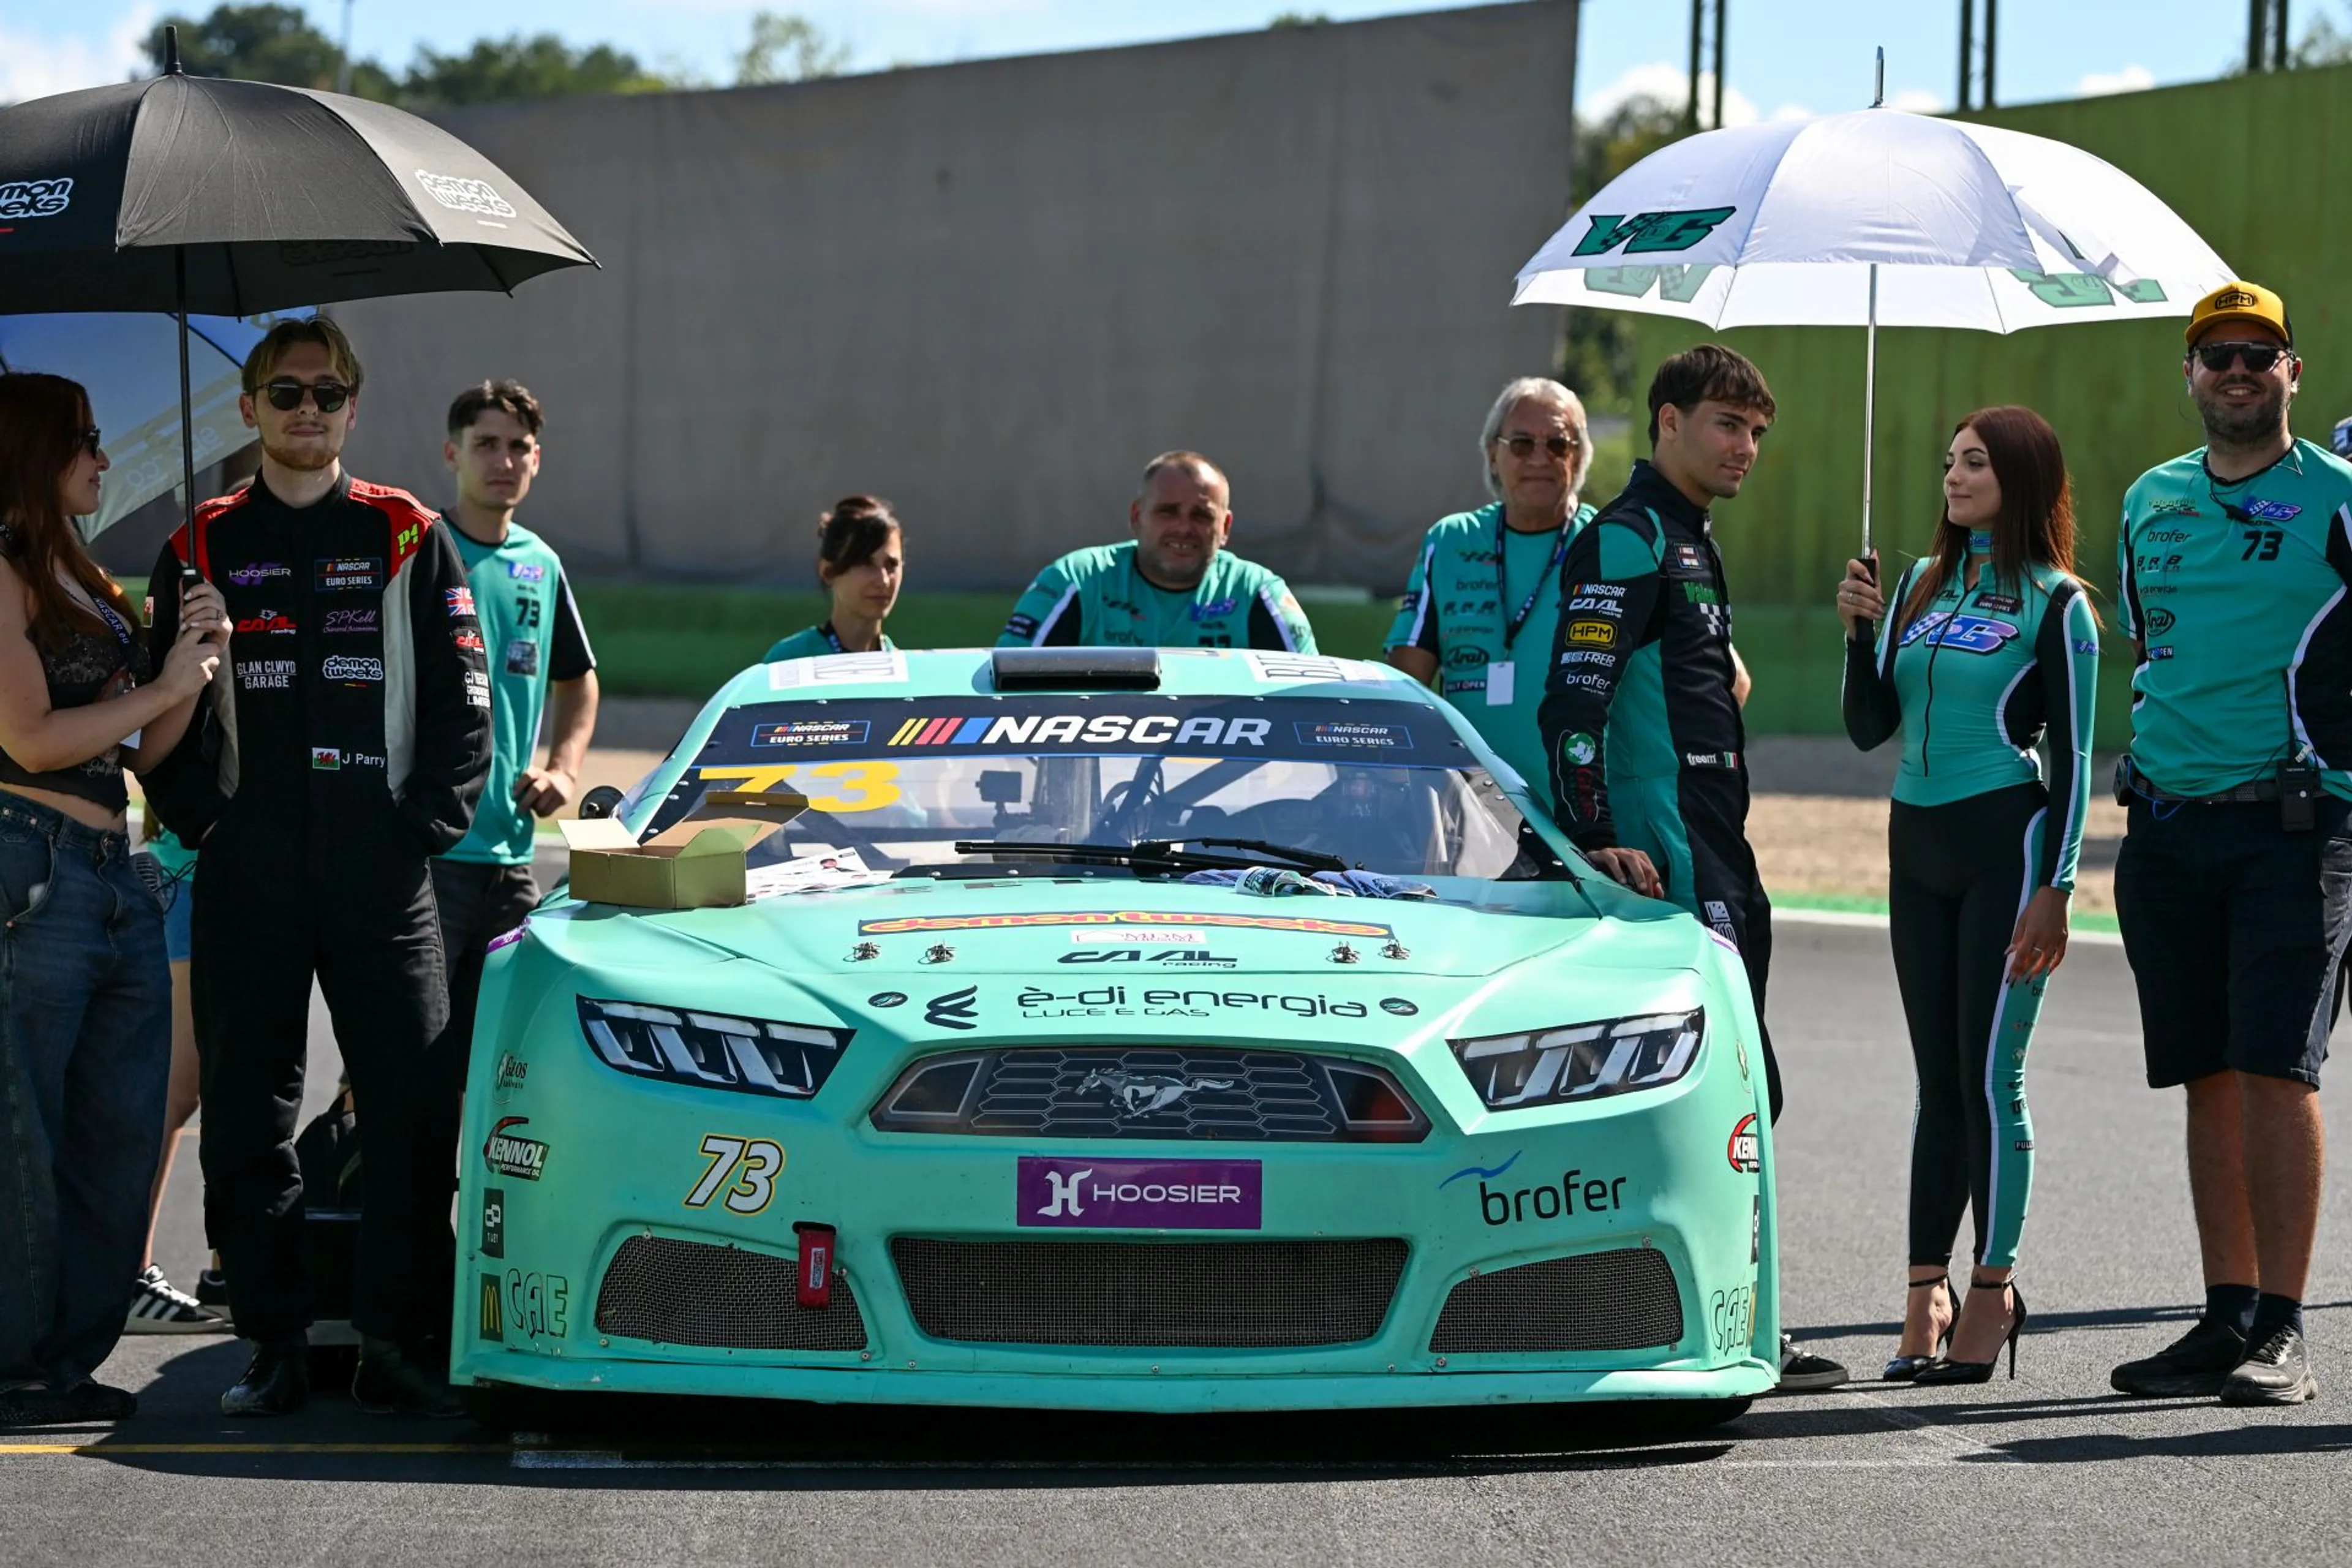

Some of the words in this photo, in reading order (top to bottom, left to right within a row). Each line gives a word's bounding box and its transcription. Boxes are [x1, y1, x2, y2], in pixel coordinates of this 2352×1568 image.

[0, 178, 74, 199] mon
[2217, 293, 2252, 305] HPM
[2147, 529, 2192, 543] brofer
[2241, 530, 2284, 561] 73
[228, 568, 292, 578] HOOSIER
[336, 562, 371, 571] NASCAR
[325, 576, 347, 586] EURO
[347, 576, 372, 585] SERIES
[1584, 583, 1627, 598] NASCAR
[515, 597, 542, 628] 73
[1572, 625, 1611, 641] HPM
[236, 662, 262, 675] GLAN
[264, 660, 296, 674] CLWYD
[323, 655, 381, 669] demon
[322, 666, 383, 680] tweeks
[244, 674, 290, 690] GARAGE
[1566, 673, 1611, 691] brofer
[792, 723, 851, 733] NASCAR
[981, 716, 1272, 746] NASCAR
[1332, 725, 1389, 735] NASCAR
[769, 735, 804, 744] EURO
[805, 734, 849, 742] SERIES
[1316, 736, 1349, 744] EURO
[1352, 736, 1395, 746] SERIES
[342, 753, 351, 764] J
[355, 753, 386, 768] Parry
[1057, 949, 1238, 963] CAAL
[1017, 986, 1126, 1008] è-di
[1144, 989, 1368, 1018] energia
[1022, 1008, 1106, 1019] LUCE
[1115, 1008, 1135, 1016] E
[1144, 1008, 1210, 1017] GAS
[489, 1136, 544, 1168] KENNOL
[500, 1163, 532, 1177] PERFORMANCE
[683, 1134, 785, 1216] 73
[1093, 1183, 1241, 1204] HOOSIER
[1479, 1169, 1627, 1226] brofer
[505, 1267, 568, 1339] CAE
